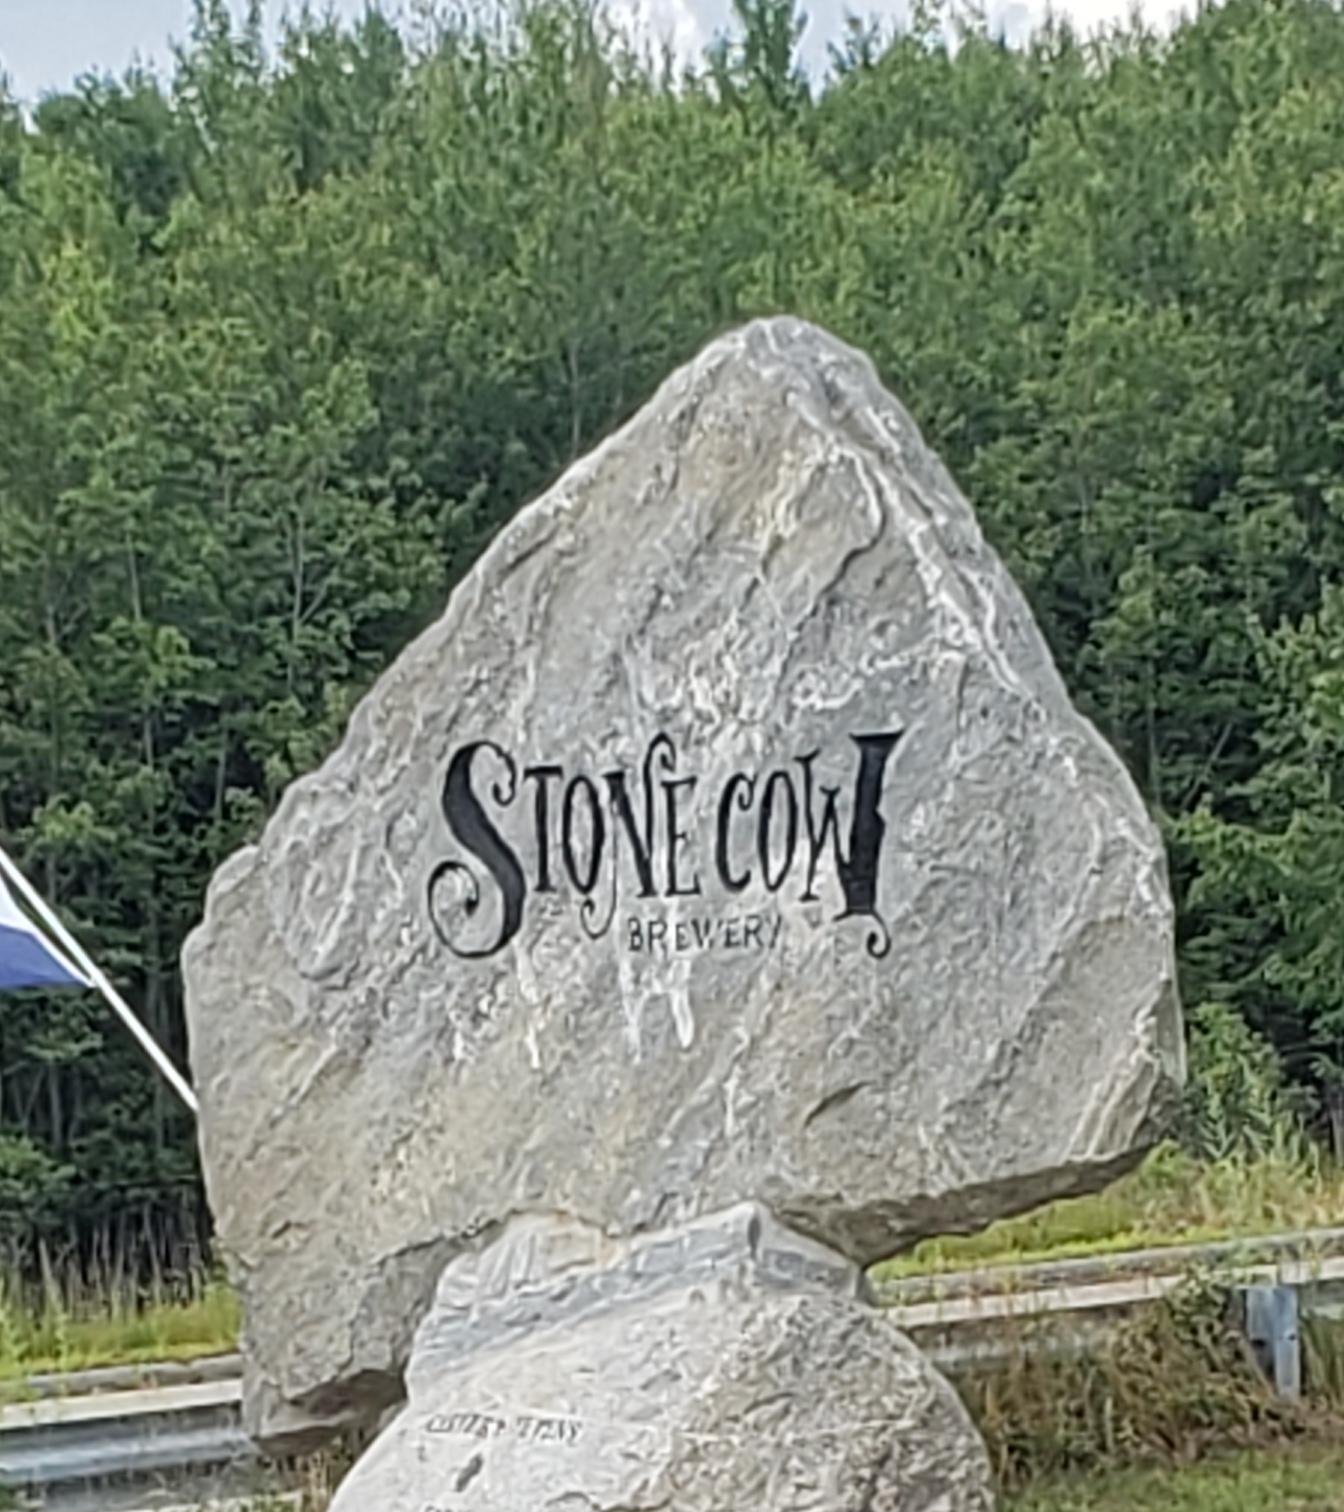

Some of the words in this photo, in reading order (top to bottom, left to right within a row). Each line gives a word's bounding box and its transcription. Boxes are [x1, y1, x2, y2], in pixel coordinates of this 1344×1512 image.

[427, 733, 701, 958] STONE
[715, 730, 906, 958] COW
[626, 914, 784, 952] BREWERY
